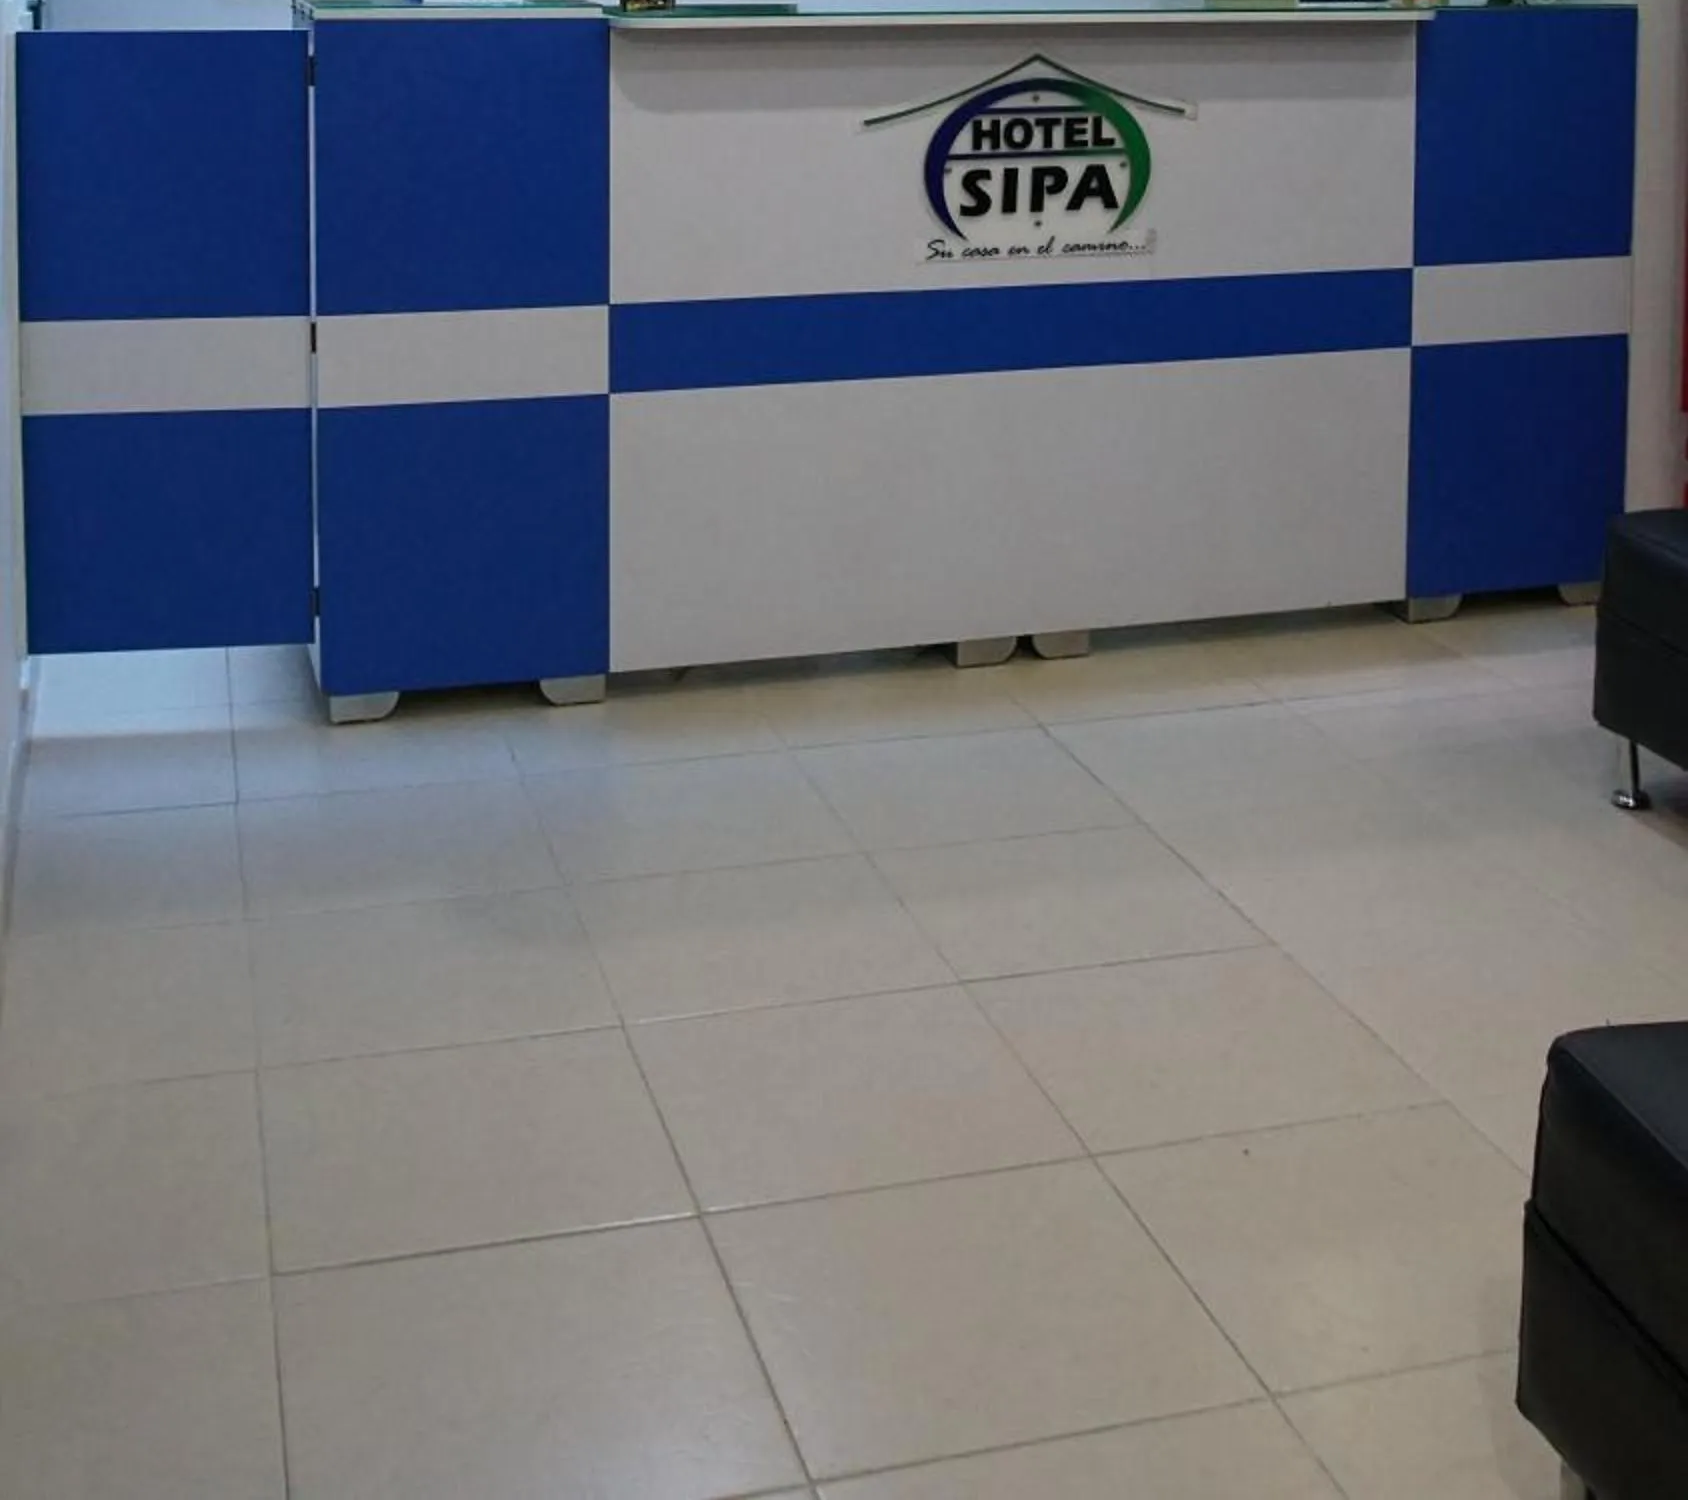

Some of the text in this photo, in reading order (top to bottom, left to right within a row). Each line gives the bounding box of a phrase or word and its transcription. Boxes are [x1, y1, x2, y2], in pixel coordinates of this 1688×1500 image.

[971, 115, 1116, 151] HOTEL
[959, 164, 1119, 217] SIPA
[926, 239, 954, 261] Su
[961, 245, 1000, 258] casa
[1007, 245, 1030, 257] en
[1037, 235, 1056, 256] el
